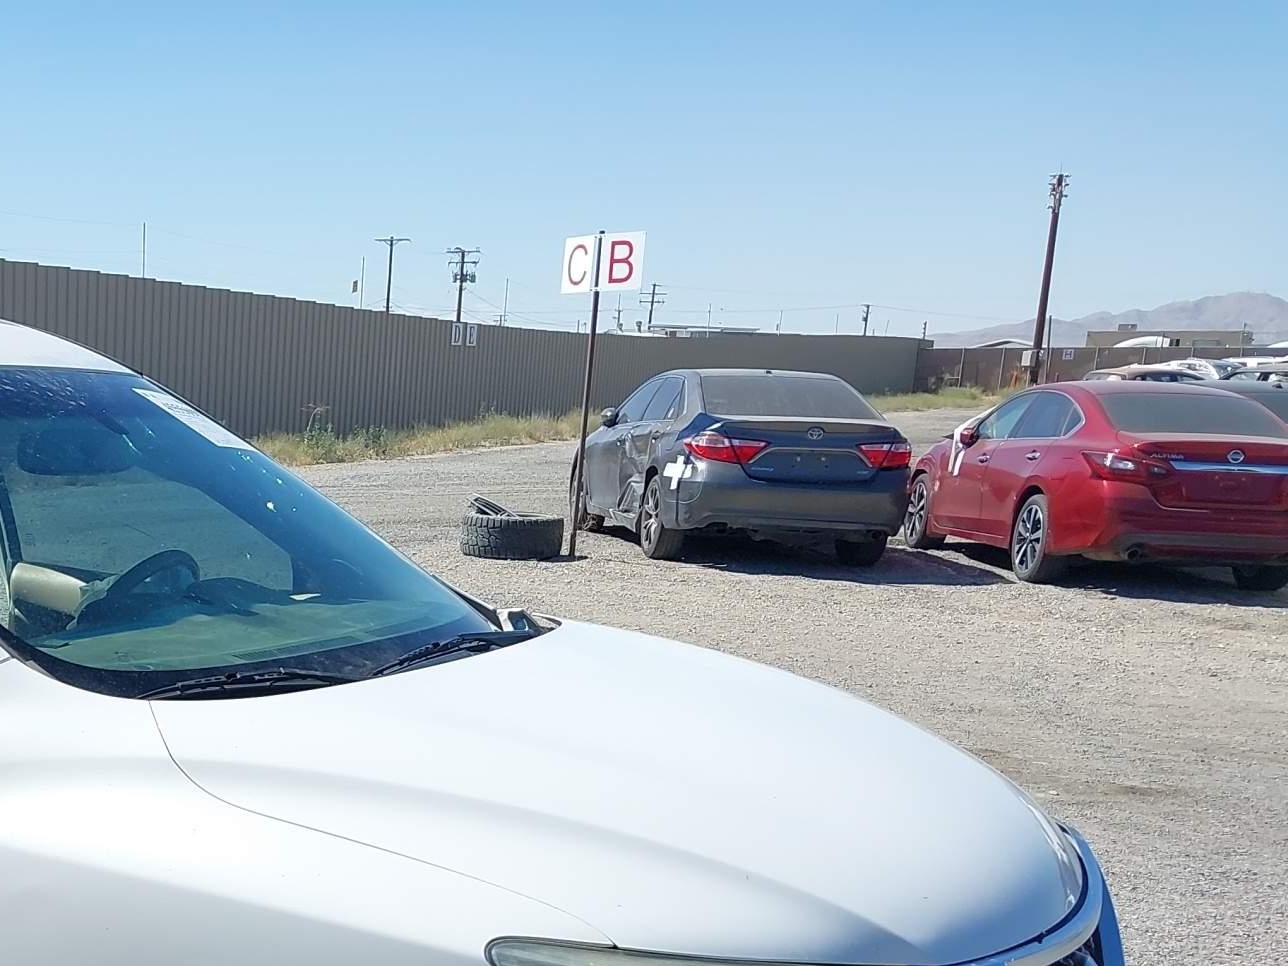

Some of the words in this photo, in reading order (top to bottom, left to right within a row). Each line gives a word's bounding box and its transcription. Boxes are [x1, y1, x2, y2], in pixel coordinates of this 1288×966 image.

[568, 244, 588, 286] C
[608, 240, 634, 284] B
[454, 325, 461, 344] D
[469, 326, 476, 345] E
[1150, 452, 1185, 460] ALTIMA
